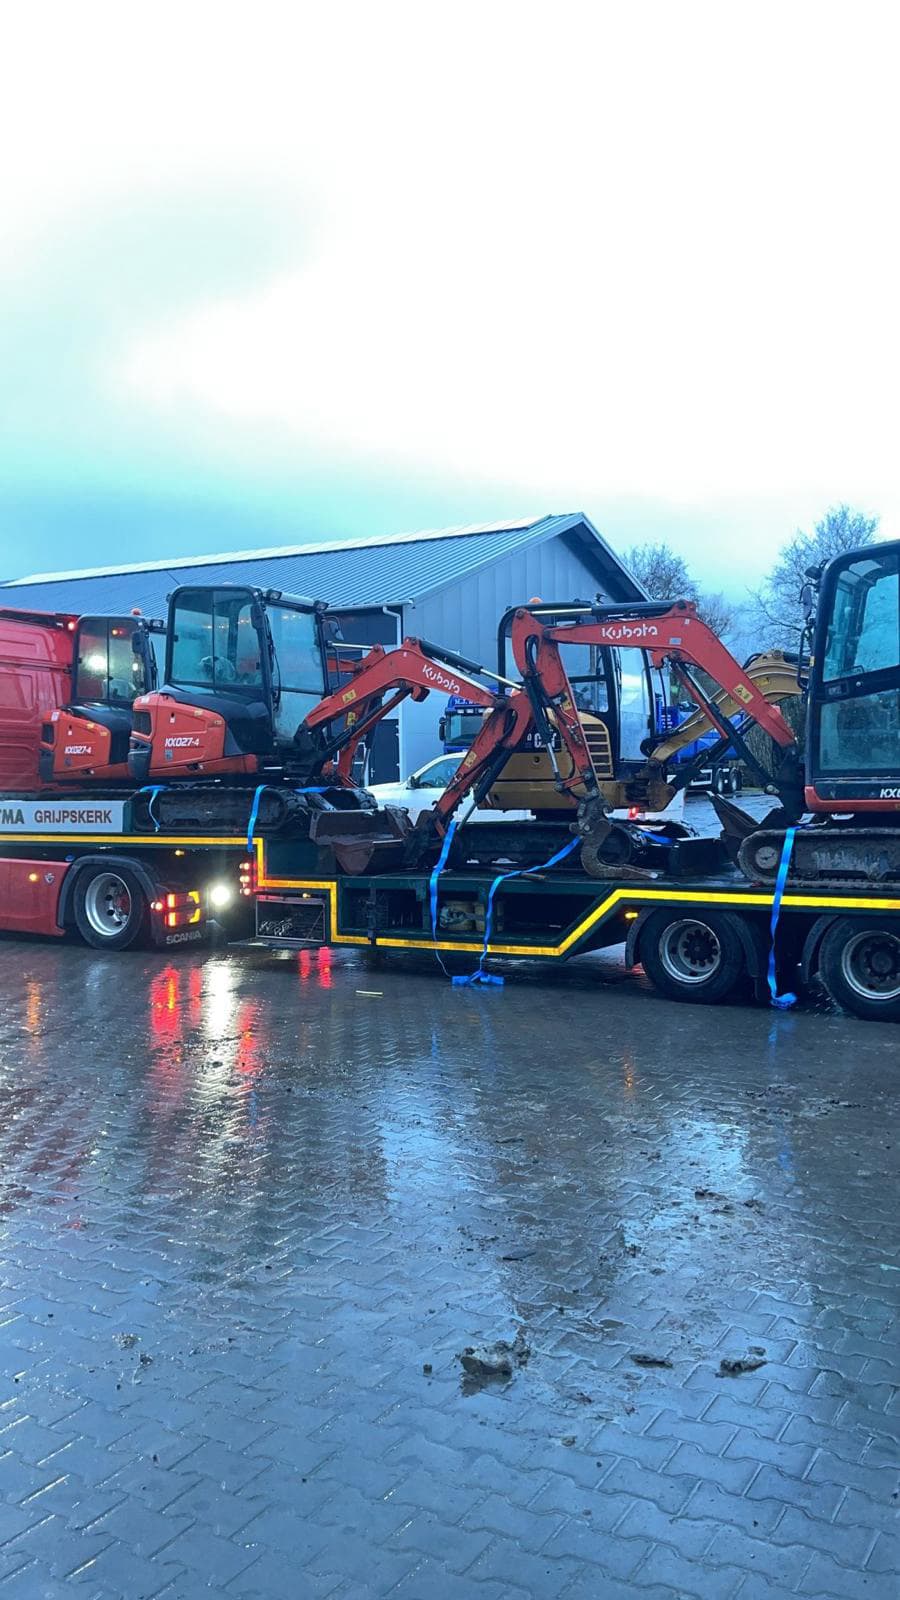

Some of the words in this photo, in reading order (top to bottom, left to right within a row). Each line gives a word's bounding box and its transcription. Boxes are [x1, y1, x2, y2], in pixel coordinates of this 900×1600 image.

[601, 623, 658, 640] Kubota
[422, 664, 460, 694] Kubota
[164, 737, 200, 748] KX027-4
[0, 808, 25, 825] MA
[34, 809, 113, 824] GRIJPSKERK
[166, 930, 202, 945] SCANIA
